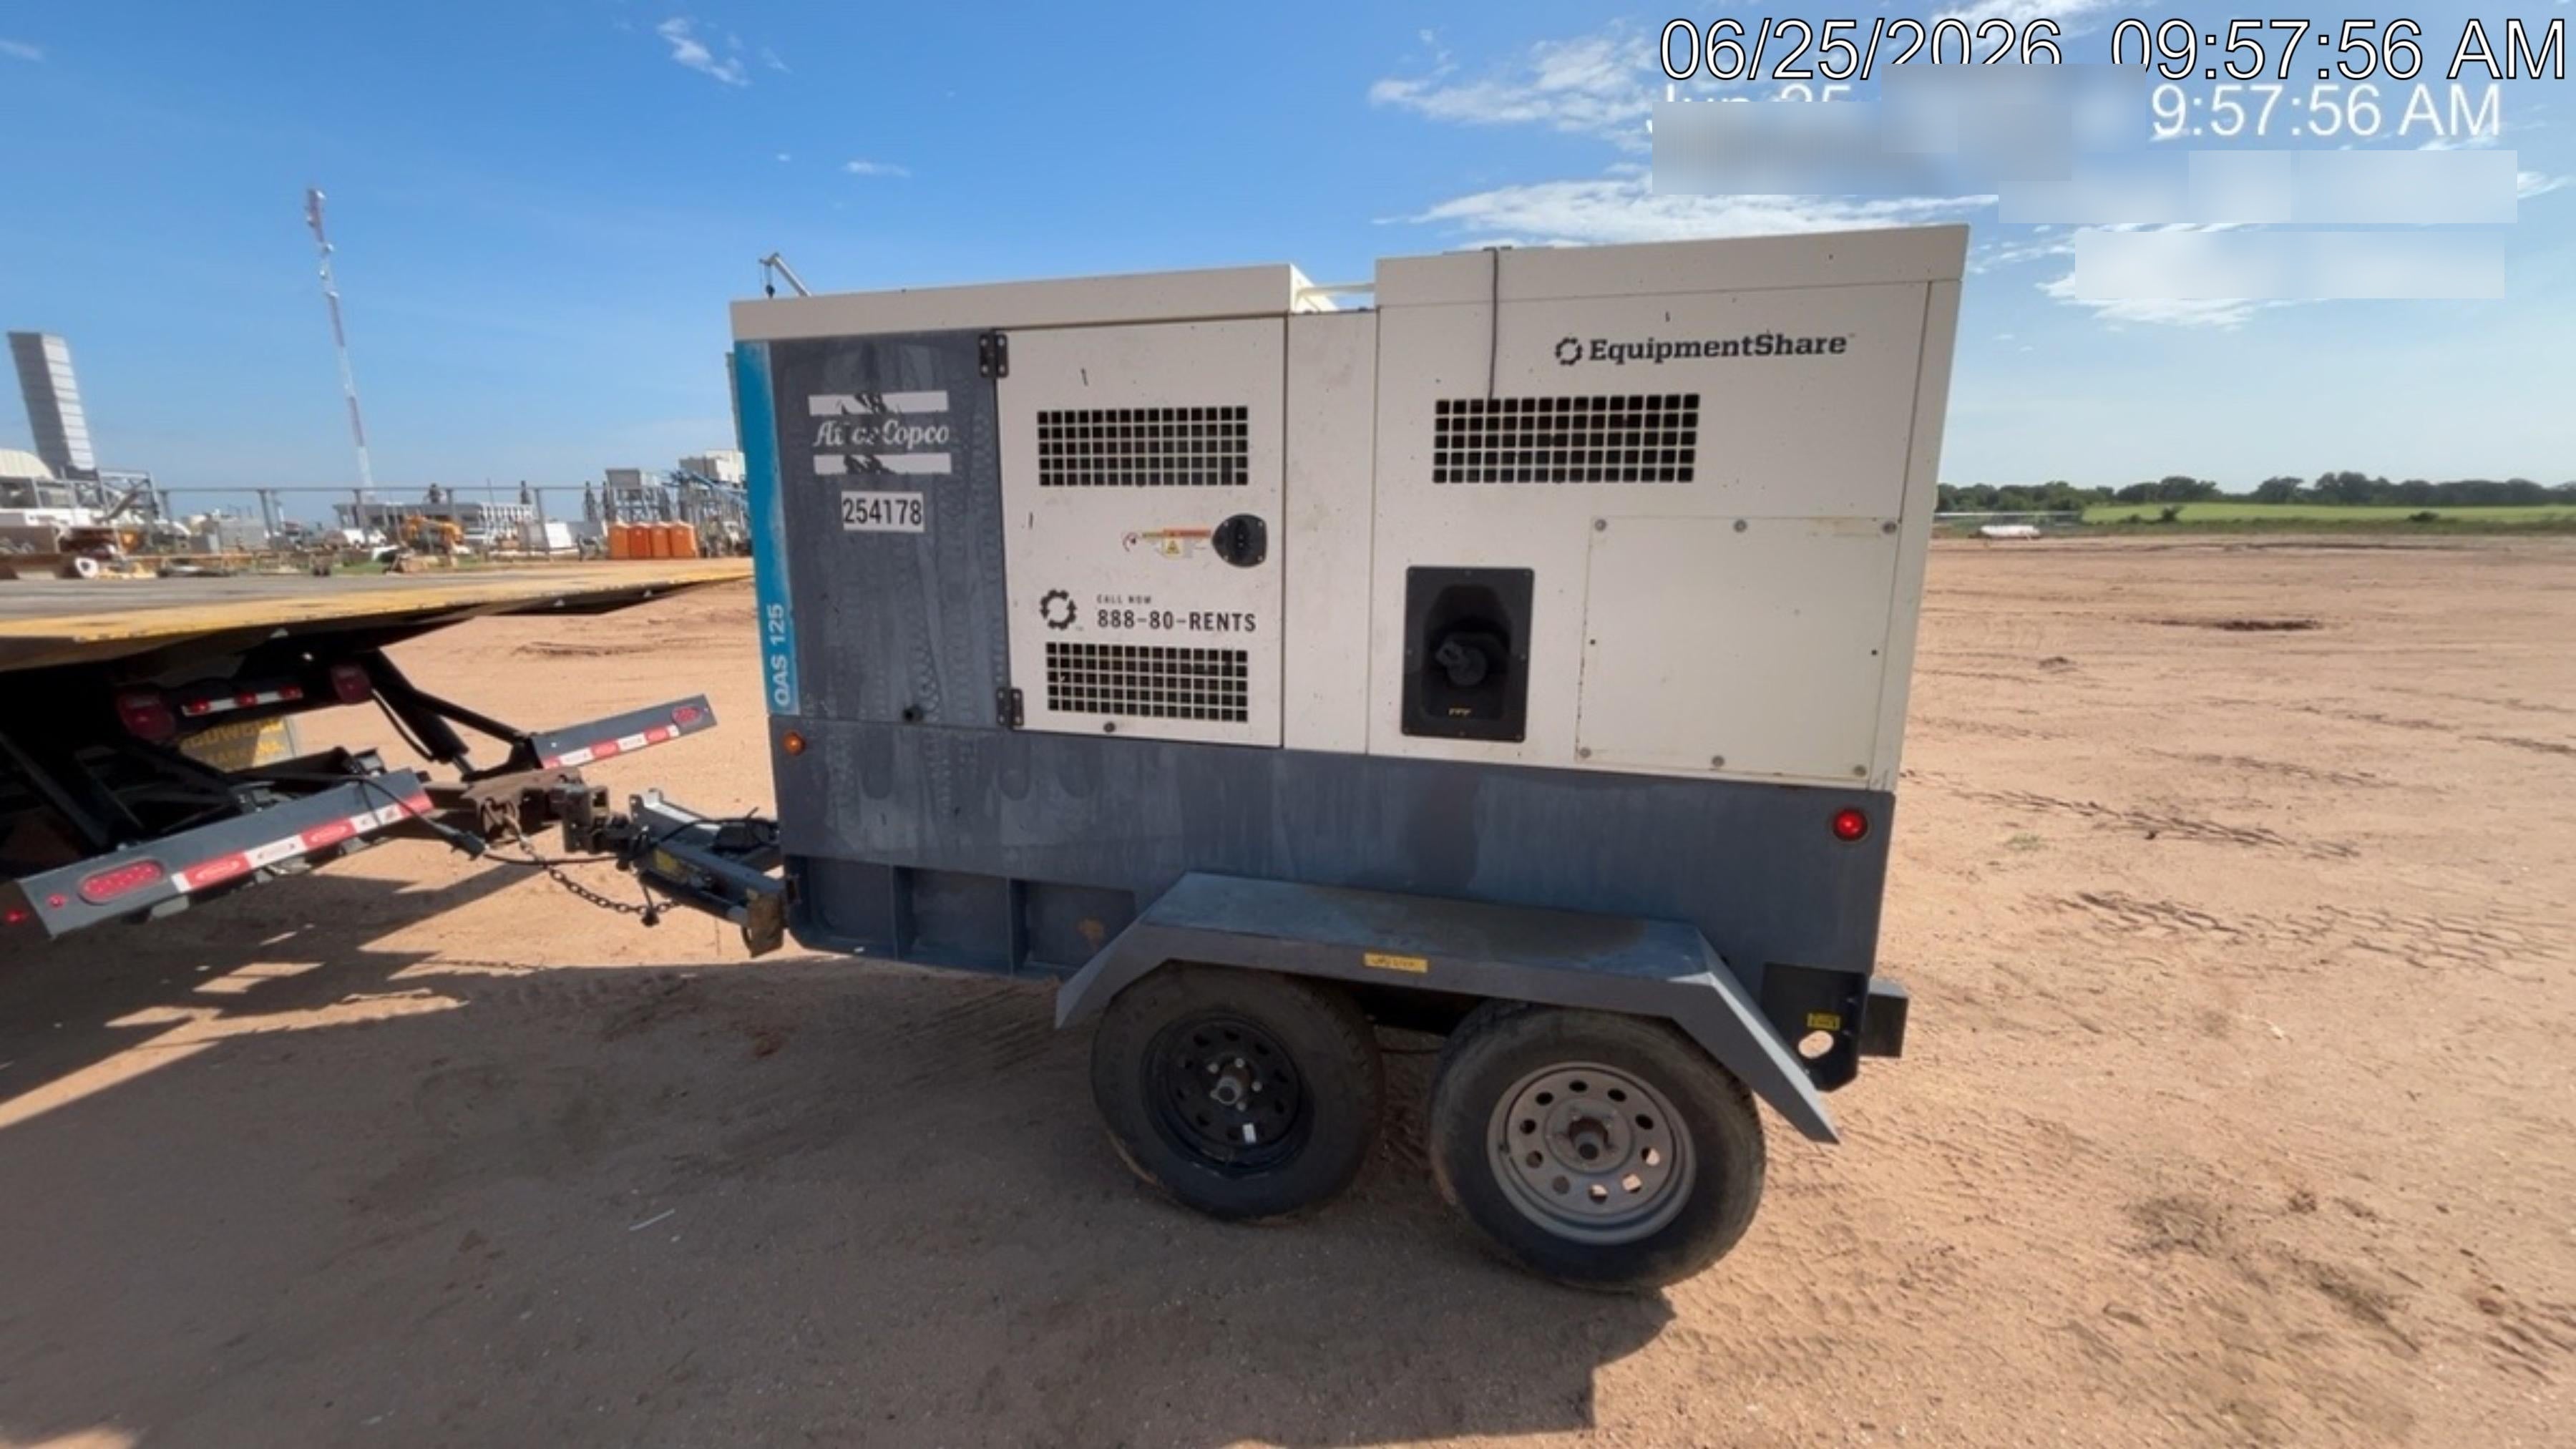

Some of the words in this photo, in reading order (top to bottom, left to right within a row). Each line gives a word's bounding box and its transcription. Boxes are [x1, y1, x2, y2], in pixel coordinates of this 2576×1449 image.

[1589, 333, 1847, 365] EquipmentShare
[881, 419, 950, 450] Copco
[843, 498, 922, 525] 254178
[1096, 595, 1123, 604] CALL
[1128, 595, 1151, 604] NOW
[766, 602, 786, 647] 125
[1098, 609, 1257, 632] 888-80-RENTS
